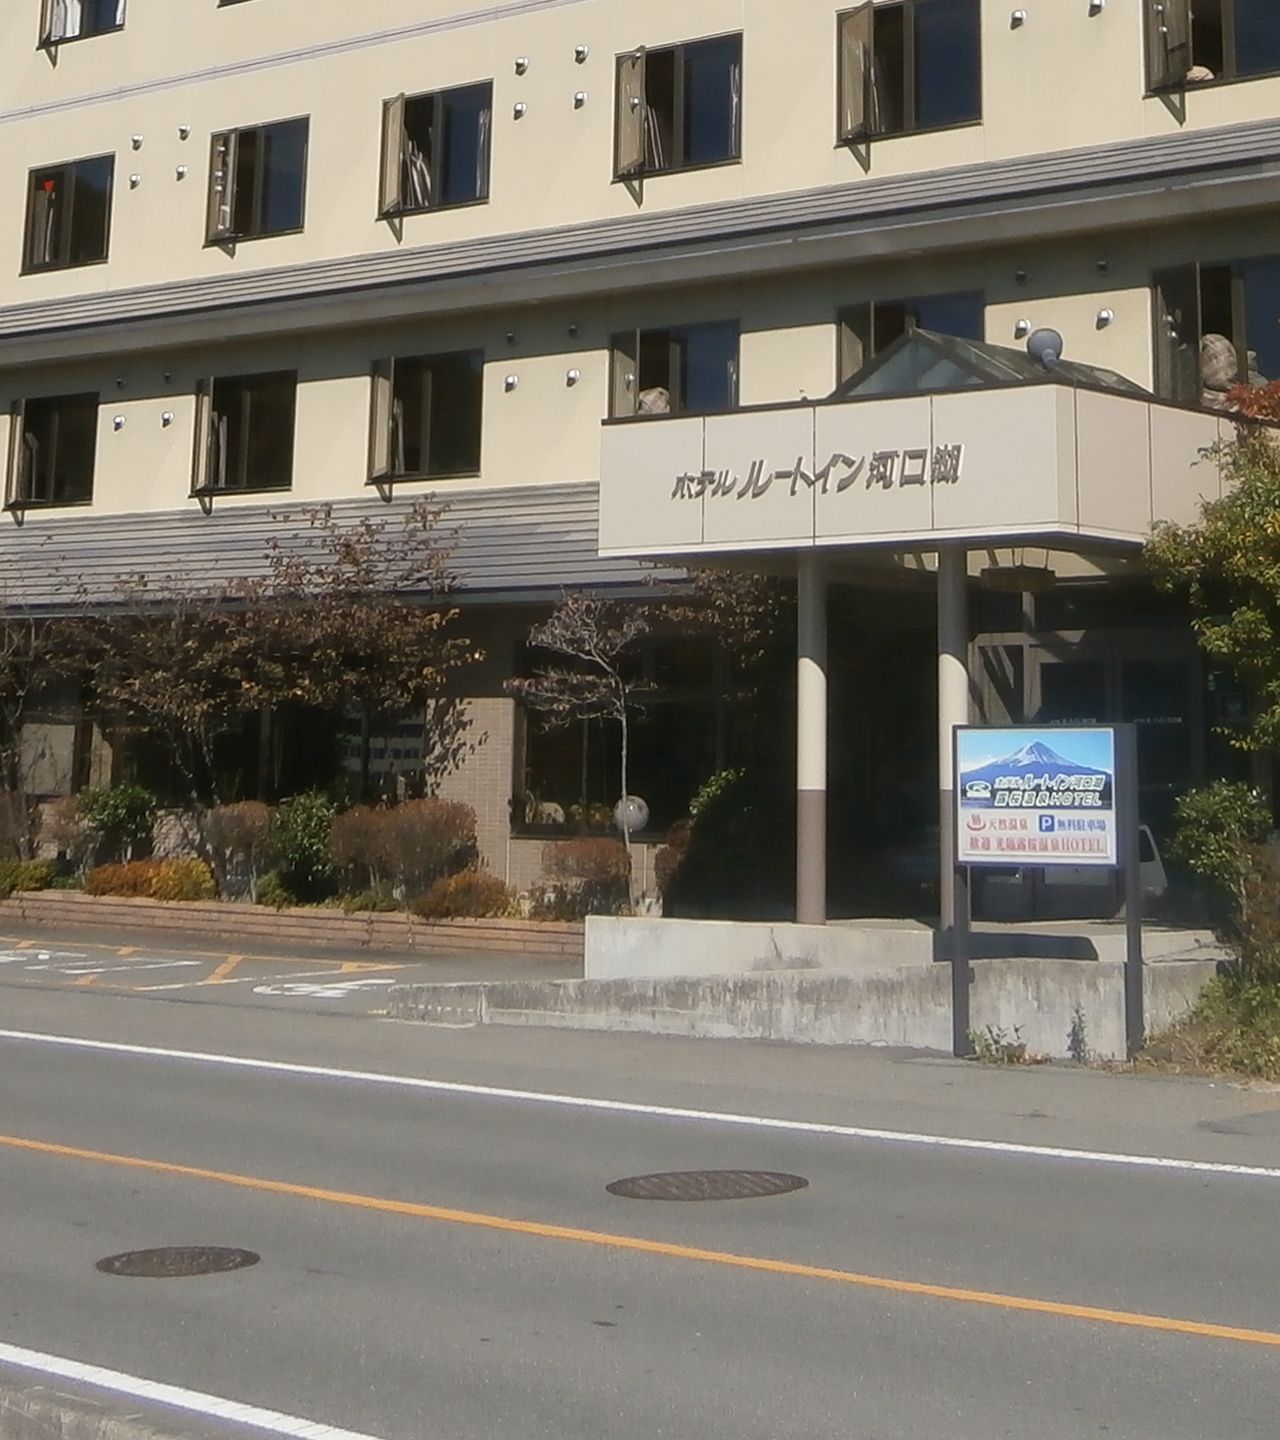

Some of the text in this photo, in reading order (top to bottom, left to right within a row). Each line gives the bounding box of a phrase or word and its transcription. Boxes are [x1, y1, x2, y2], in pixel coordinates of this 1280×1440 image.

[671, 444, 963, 500] ホテルルートイン河口湖
[989, 819, 1029, 831] 天然温泉
[1057, 818, 1107, 832] 無料駐車場
